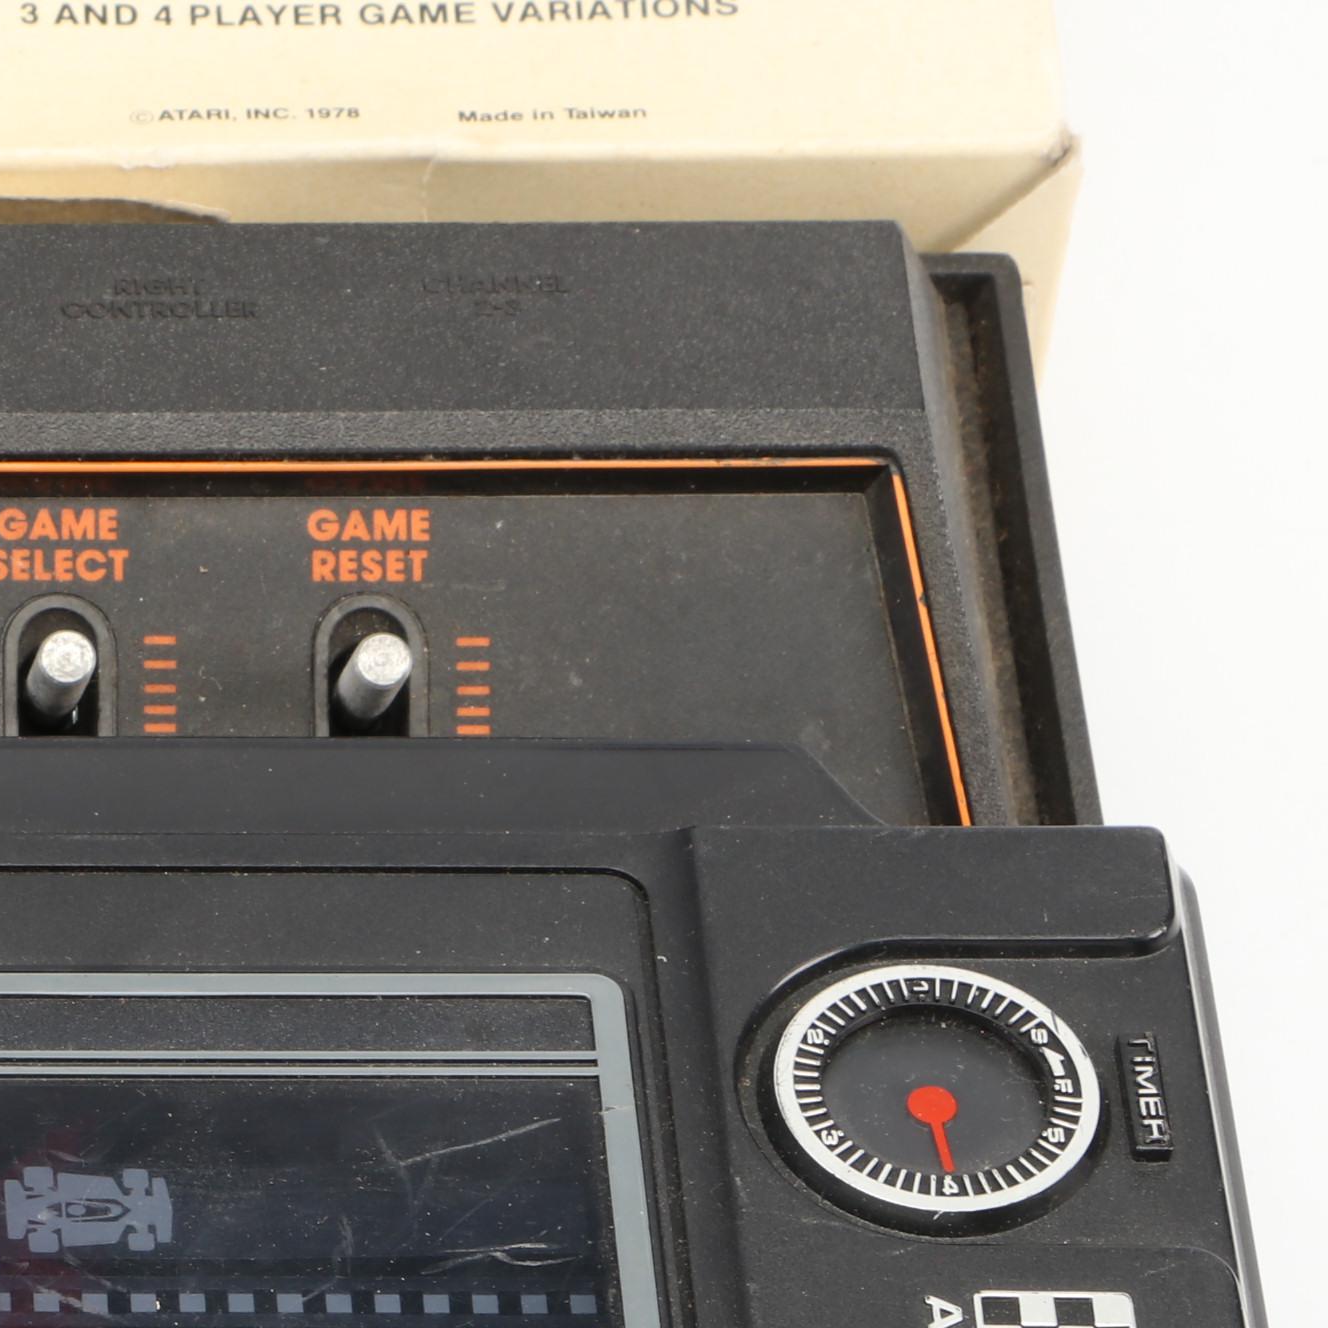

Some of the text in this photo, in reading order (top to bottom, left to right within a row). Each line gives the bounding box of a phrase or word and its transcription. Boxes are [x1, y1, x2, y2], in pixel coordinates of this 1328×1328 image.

[19, 0, 740, 27] 3 AND 4 PLAYER GAME VARIATIONS
[245, 106, 298, 121] INC.
[305, 105, 362, 120] 1978
[457, 106, 648, 124] Made in Taiwan
[59, 301, 259, 320] CONTROLLER
[306, 507, 431, 542] GAME
[309, 548, 428, 584] RESET
[1127, 1036, 1166, 1144] TIMER
